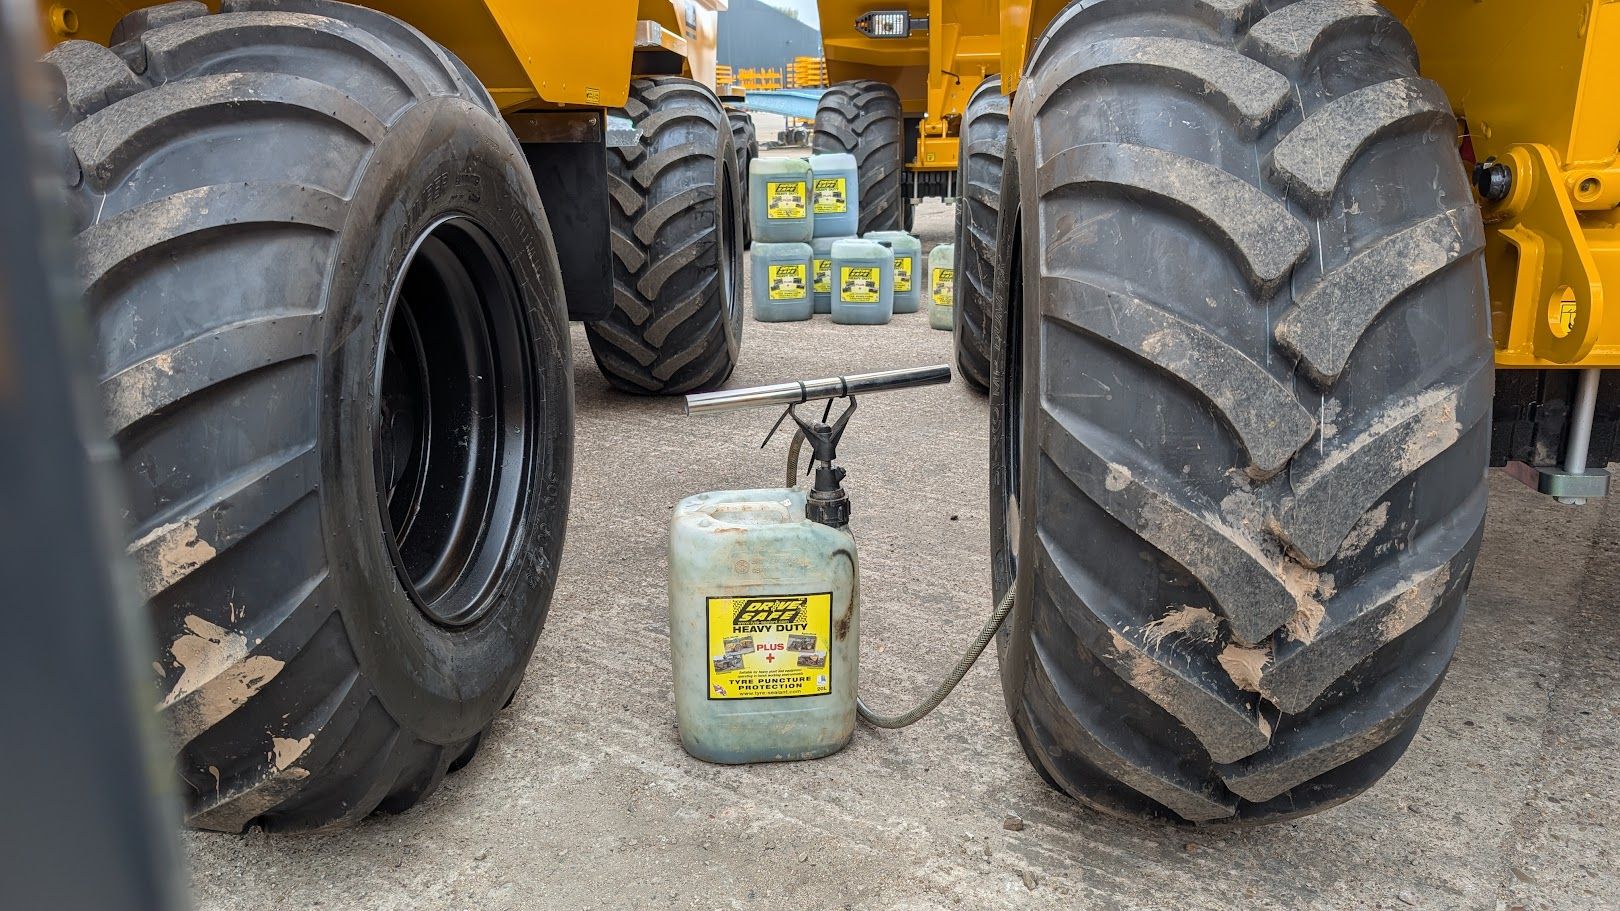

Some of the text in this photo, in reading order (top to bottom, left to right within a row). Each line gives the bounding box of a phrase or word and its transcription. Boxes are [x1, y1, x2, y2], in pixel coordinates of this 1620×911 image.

[745, 601, 803, 612] DRIVE
[738, 611, 796, 622] SAFE
[733, 623, 807, 634] HEAVY DUTY
[756, 643, 785, 652] PLUS
[758, 676, 811, 684] PUNCTURE
[738, 683, 803, 691] PROTECTION
